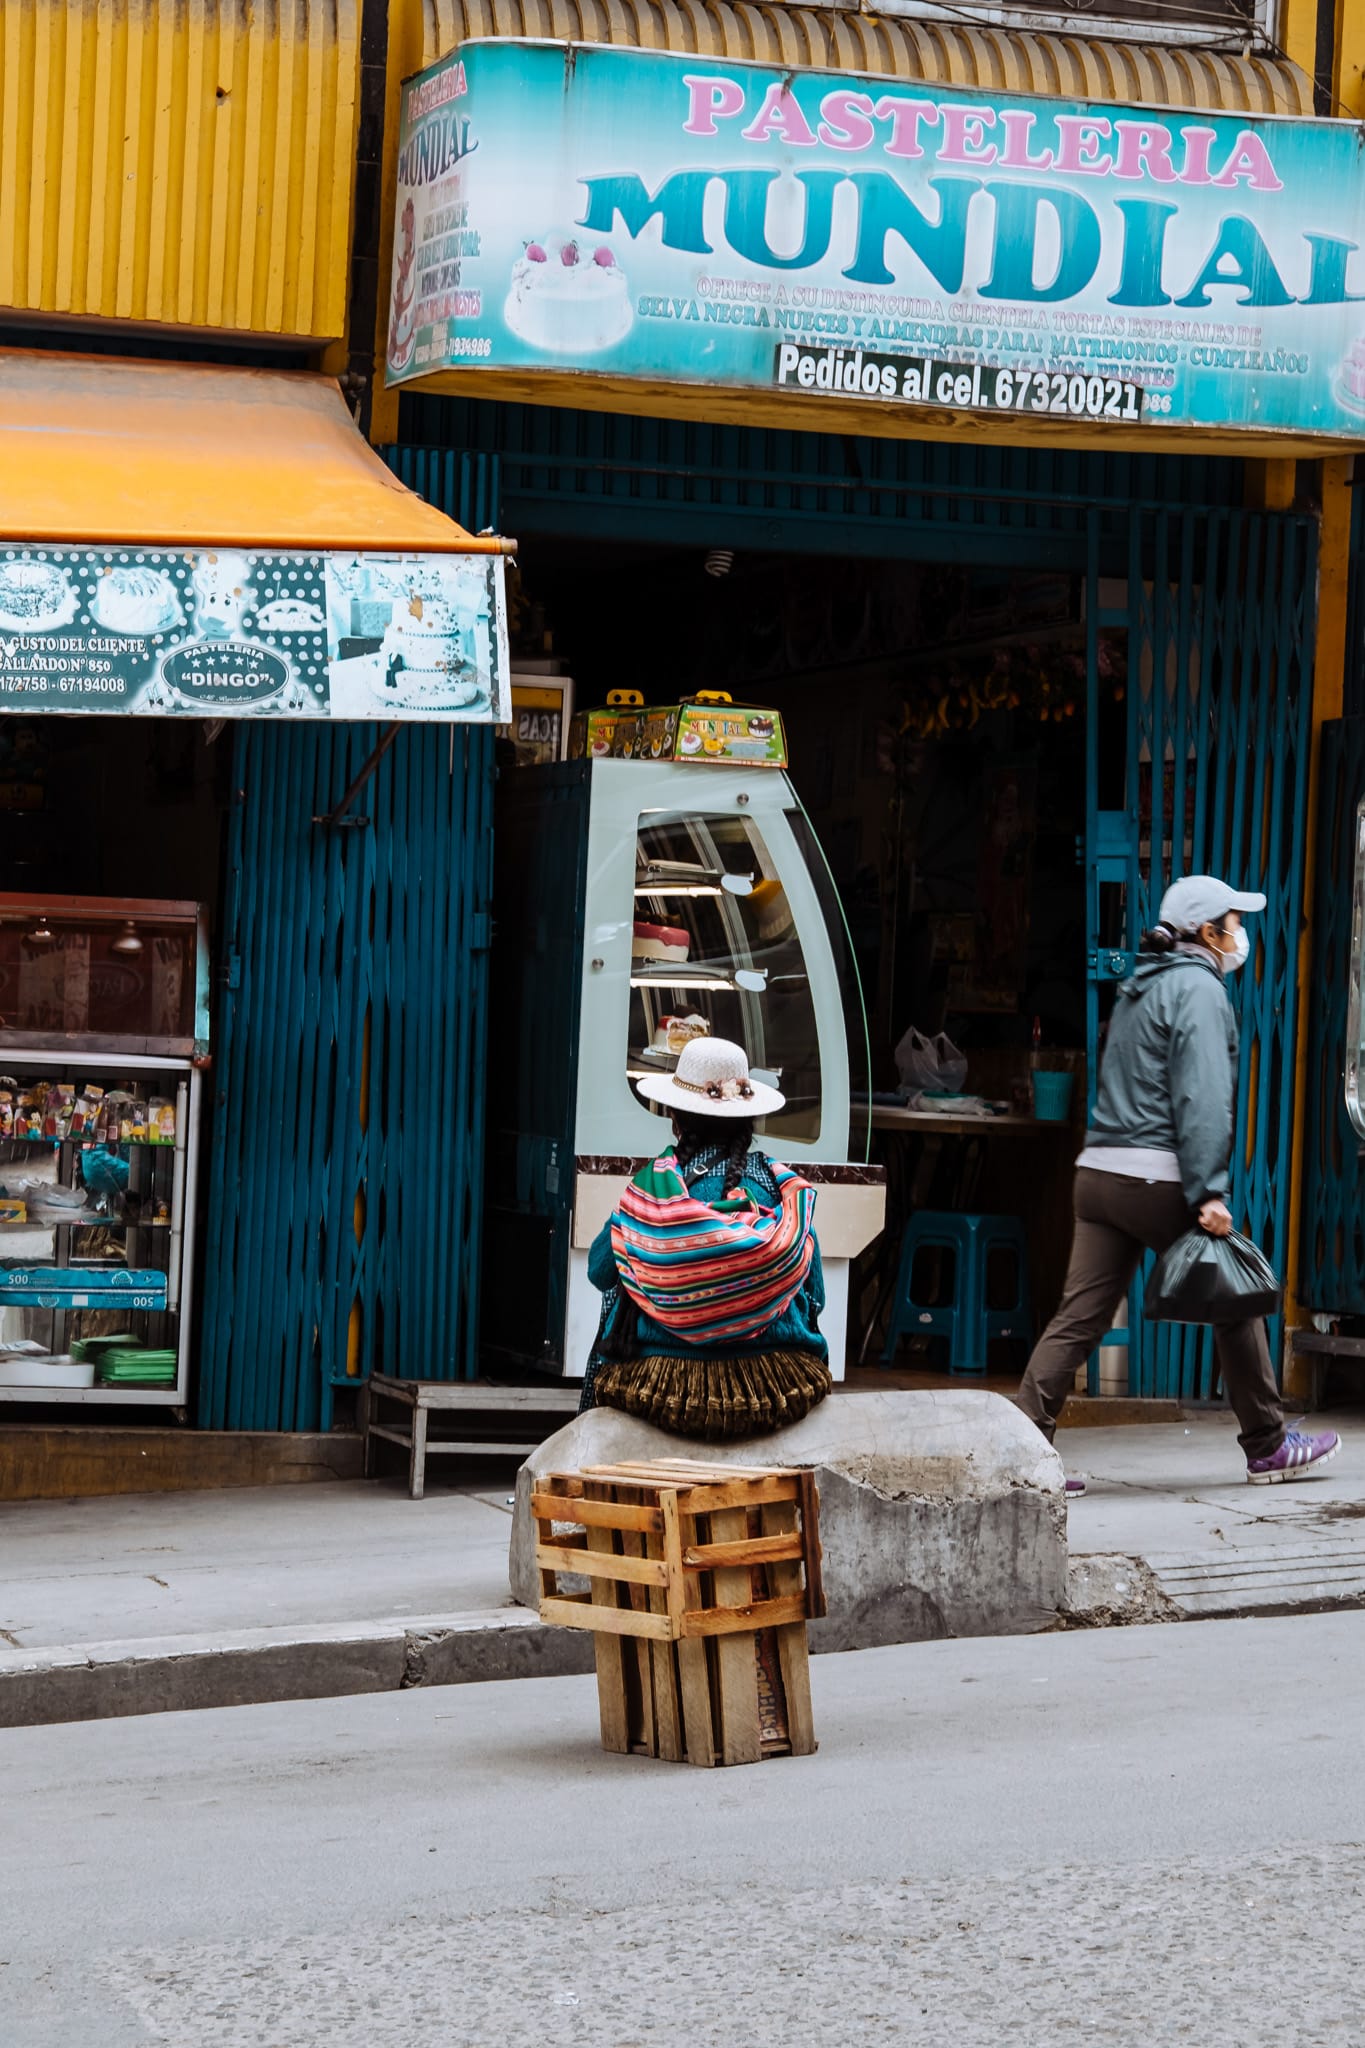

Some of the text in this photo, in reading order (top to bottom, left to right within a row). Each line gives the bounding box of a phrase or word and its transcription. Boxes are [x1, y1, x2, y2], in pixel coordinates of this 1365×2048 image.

[682, 74, 1284, 192] PASTELERIA
[399, 113, 478, 187] MUNDIAL
[574, 166, 1365, 308] MUNDIAL
[697, 276, 1262, 346] OFRECE A SU DISTINGUIDA CLIENTELA TORTAS ESPECIALES DE
[638, 296, 700, 321] SELVA
[703, 302, 771, 328] NEGRA
[774, 308, 848, 334] NUECES
[852, 315, 866, 337] Y
[868, 317, 983, 347] ALMENDRAS
[987, 329, 1043, 353] PARA:
[1050, 334, 1178, 363] MATRIMONIOS
[1190, 345, 1309, 374] CUMPLEAÑOS
[778, 343, 1139, 420] Pedidos al cel. 67320021
[1097, 362, 1175, 387] PRESTES
[11, 636, 57, 651] GUSTO
[60, 638, 86, 652] DEL
[88, 638, 146, 653] CLIENTE
[184, 643, 264, 660] PASTELERIA
[88, 659, 111, 673] 850
[60, 677, 125, 692] 67194008
[690, 719, 742, 736] MUNDIAL
[8, 1273, 29, 1286] 500
